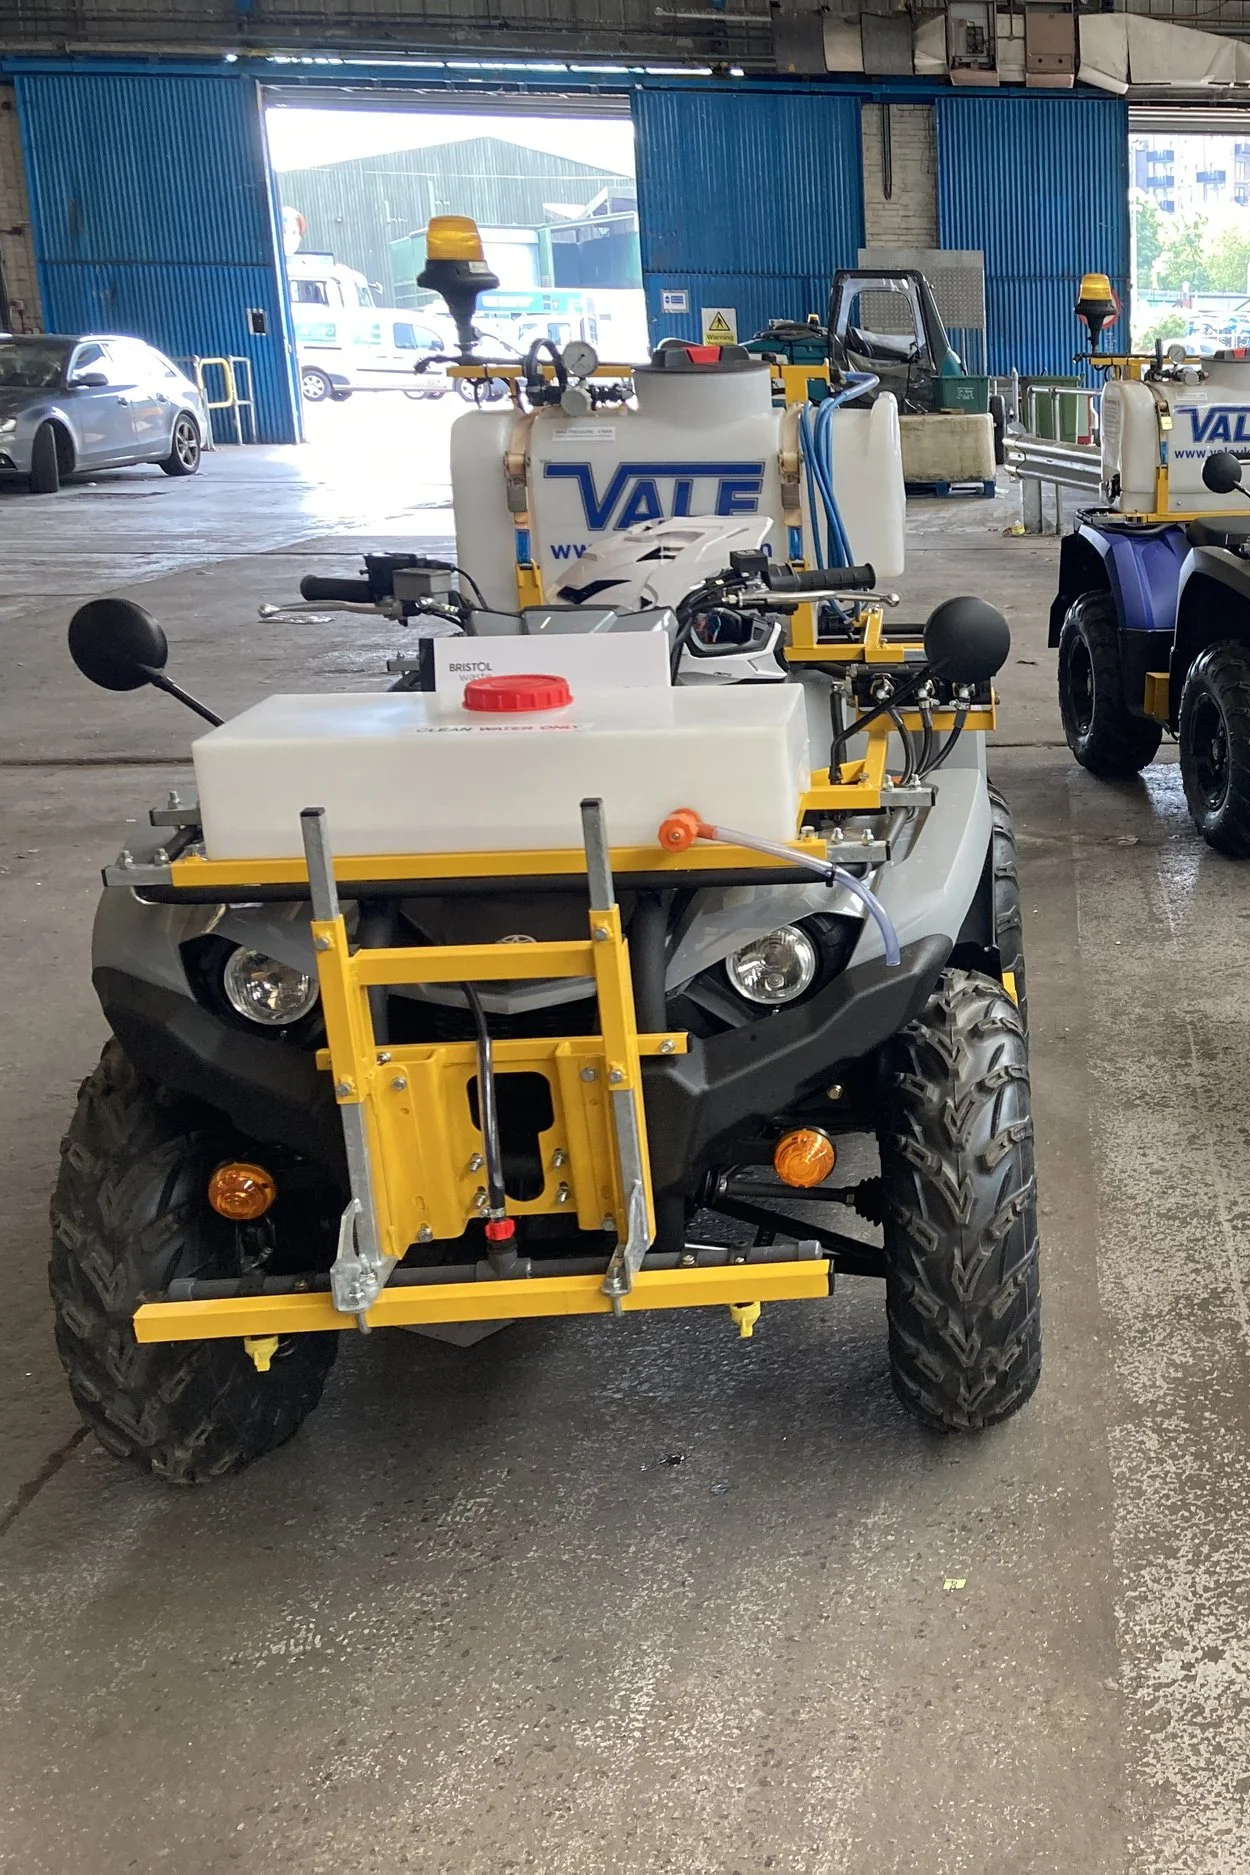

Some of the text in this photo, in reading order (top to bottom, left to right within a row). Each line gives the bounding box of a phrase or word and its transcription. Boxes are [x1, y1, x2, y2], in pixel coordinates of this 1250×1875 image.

[706, 333, 734, 341] Warning
[543, 461, 766, 531] VALE
[449, 661, 493, 672] BRISTOL
[459, 672, 492, 682] waste
